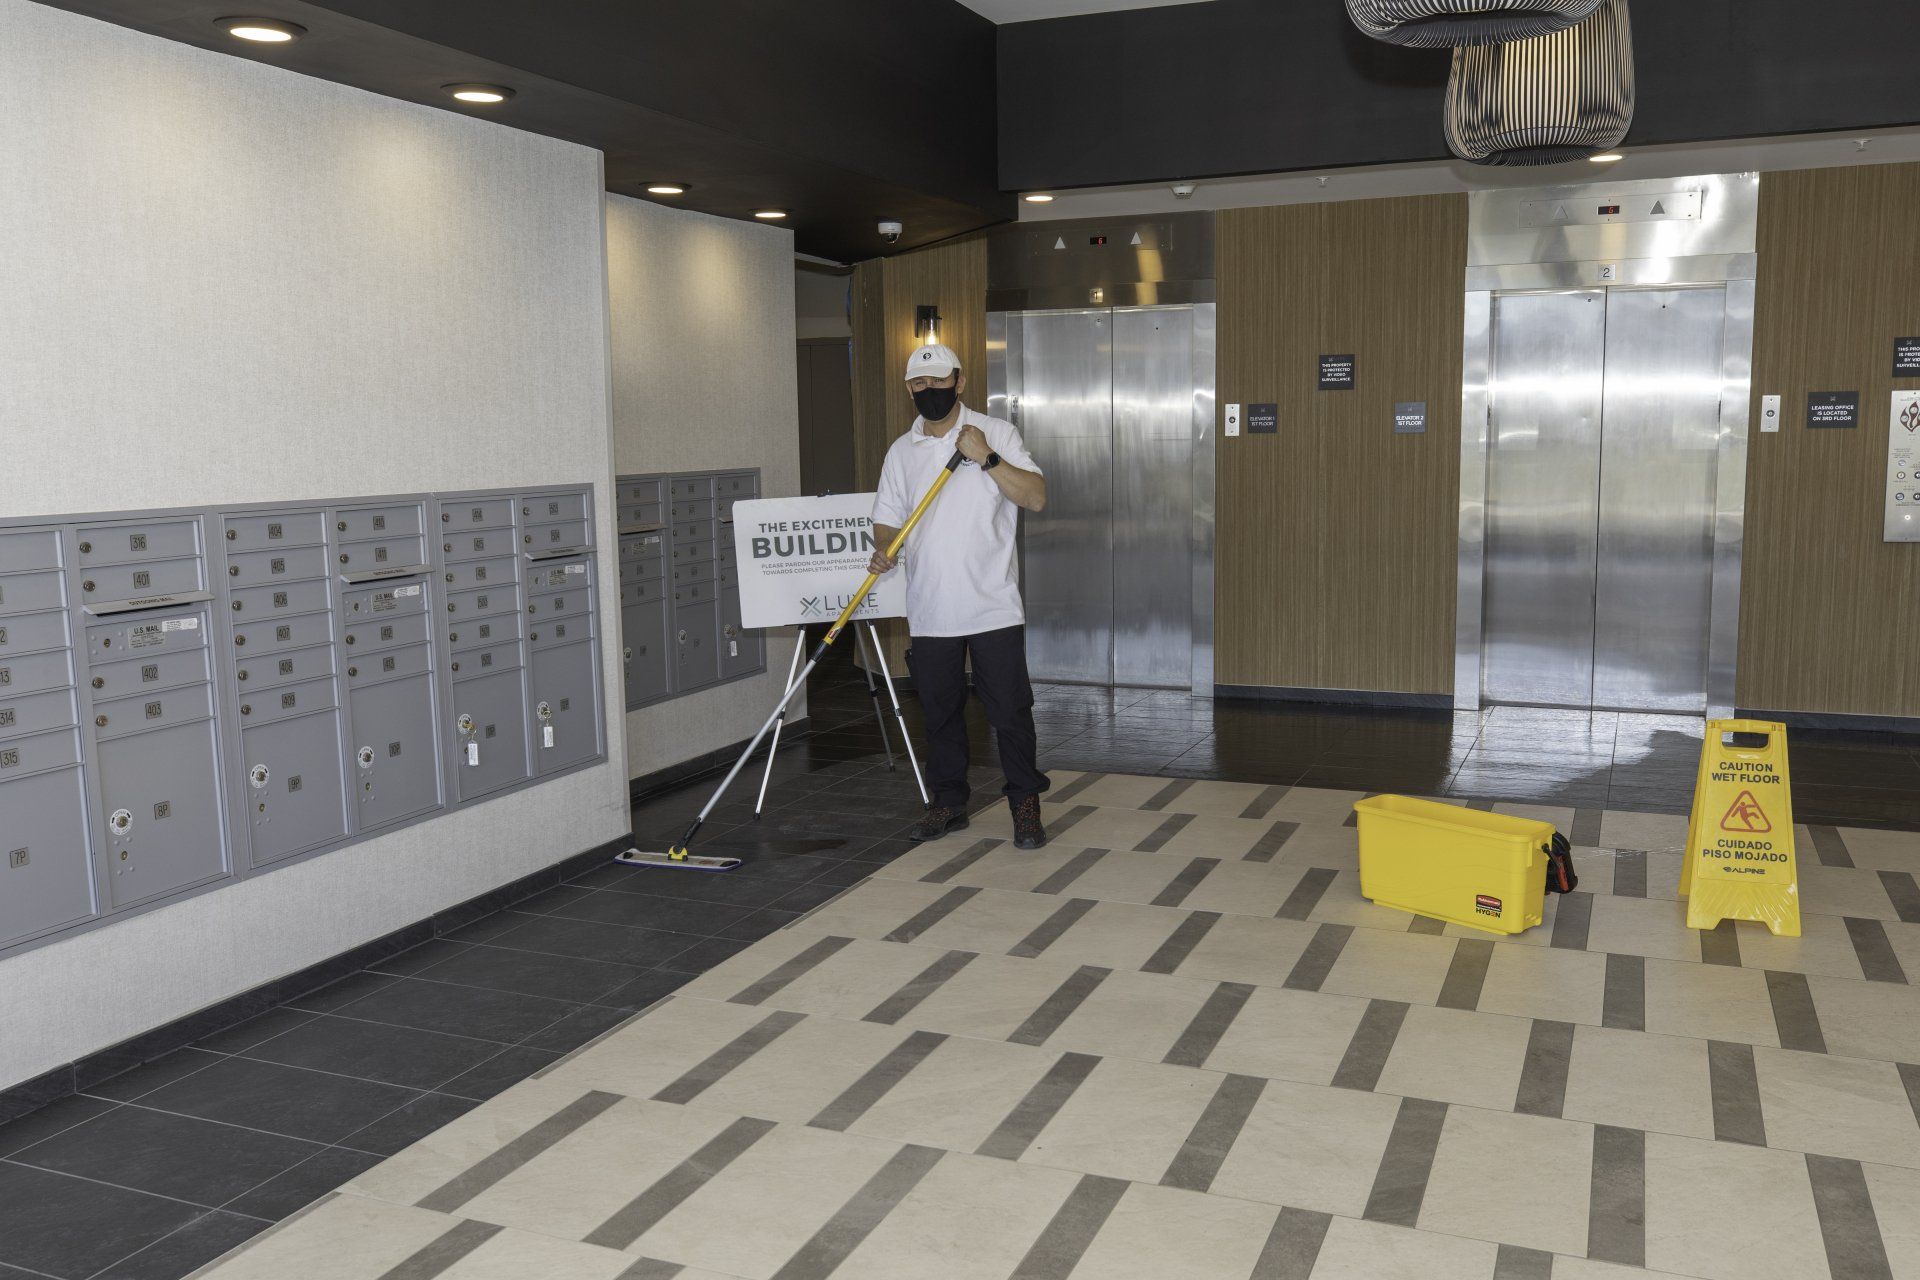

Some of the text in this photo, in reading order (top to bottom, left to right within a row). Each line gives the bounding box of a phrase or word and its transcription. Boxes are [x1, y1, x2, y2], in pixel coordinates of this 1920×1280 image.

[1603, 268, 1610, 278] 2
[270, 526, 282, 536] 404
[759, 517, 874, 533] THE EXCITEMEN
[132, 537, 146, 548] 316
[752, 531, 876, 558] BUILDIN
[272, 560, 285, 572] 405
[136, 574, 150, 587] 401
[275, 594, 288, 605] 406
[278, 627, 290, 639] 407
[0, 670, 9, 683] 13
[144, 667, 158, 679] 402
[147, 704, 161, 716] 403
[0, 712, 13, 725] 314
[3, 752, 17, 765] 315
[1719, 762, 1773, 772] CAUTION
[1712, 773, 1780, 784] WET FLOOR
[158, 805, 167, 817] 8P
[1718, 839, 1772, 850] CUIDADO
[16, 851, 26, 864] 7P
[1703, 849, 1788, 862] PISO MOJADO
